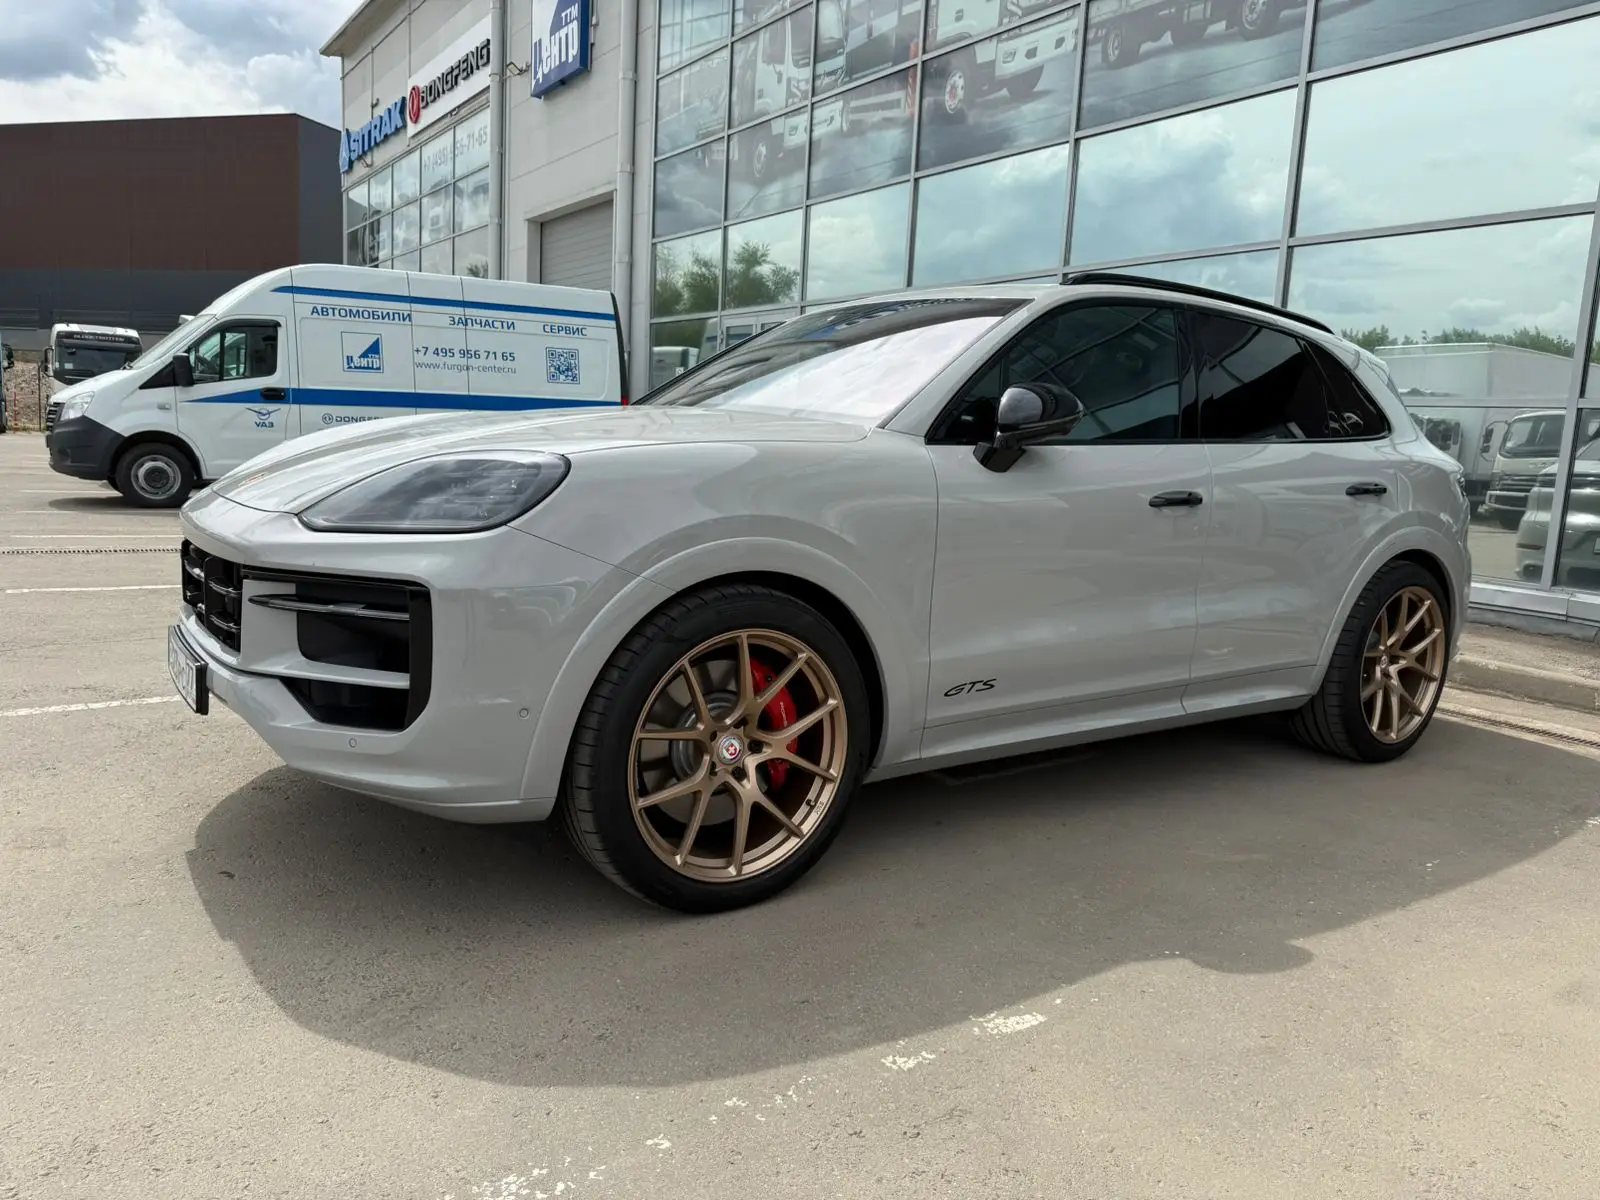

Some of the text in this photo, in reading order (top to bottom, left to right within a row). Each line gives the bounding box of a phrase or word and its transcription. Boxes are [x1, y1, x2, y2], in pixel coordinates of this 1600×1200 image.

[533, 20, 578, 84] Центр
[420, 38, 490, 109] DONGFENG
[310, 306, 412, 322] АВТОМОБИЛИ
[448, 316, 516, 330] ЗАПЧАСТИ
[542, 324, 587, 336] СЕРВИС
[414, 346, 516, 361] +7 495 956 71 65
[414, 361, 517, 374] www.furgon-center.ru
[943, 678, 997, 697] GTS
